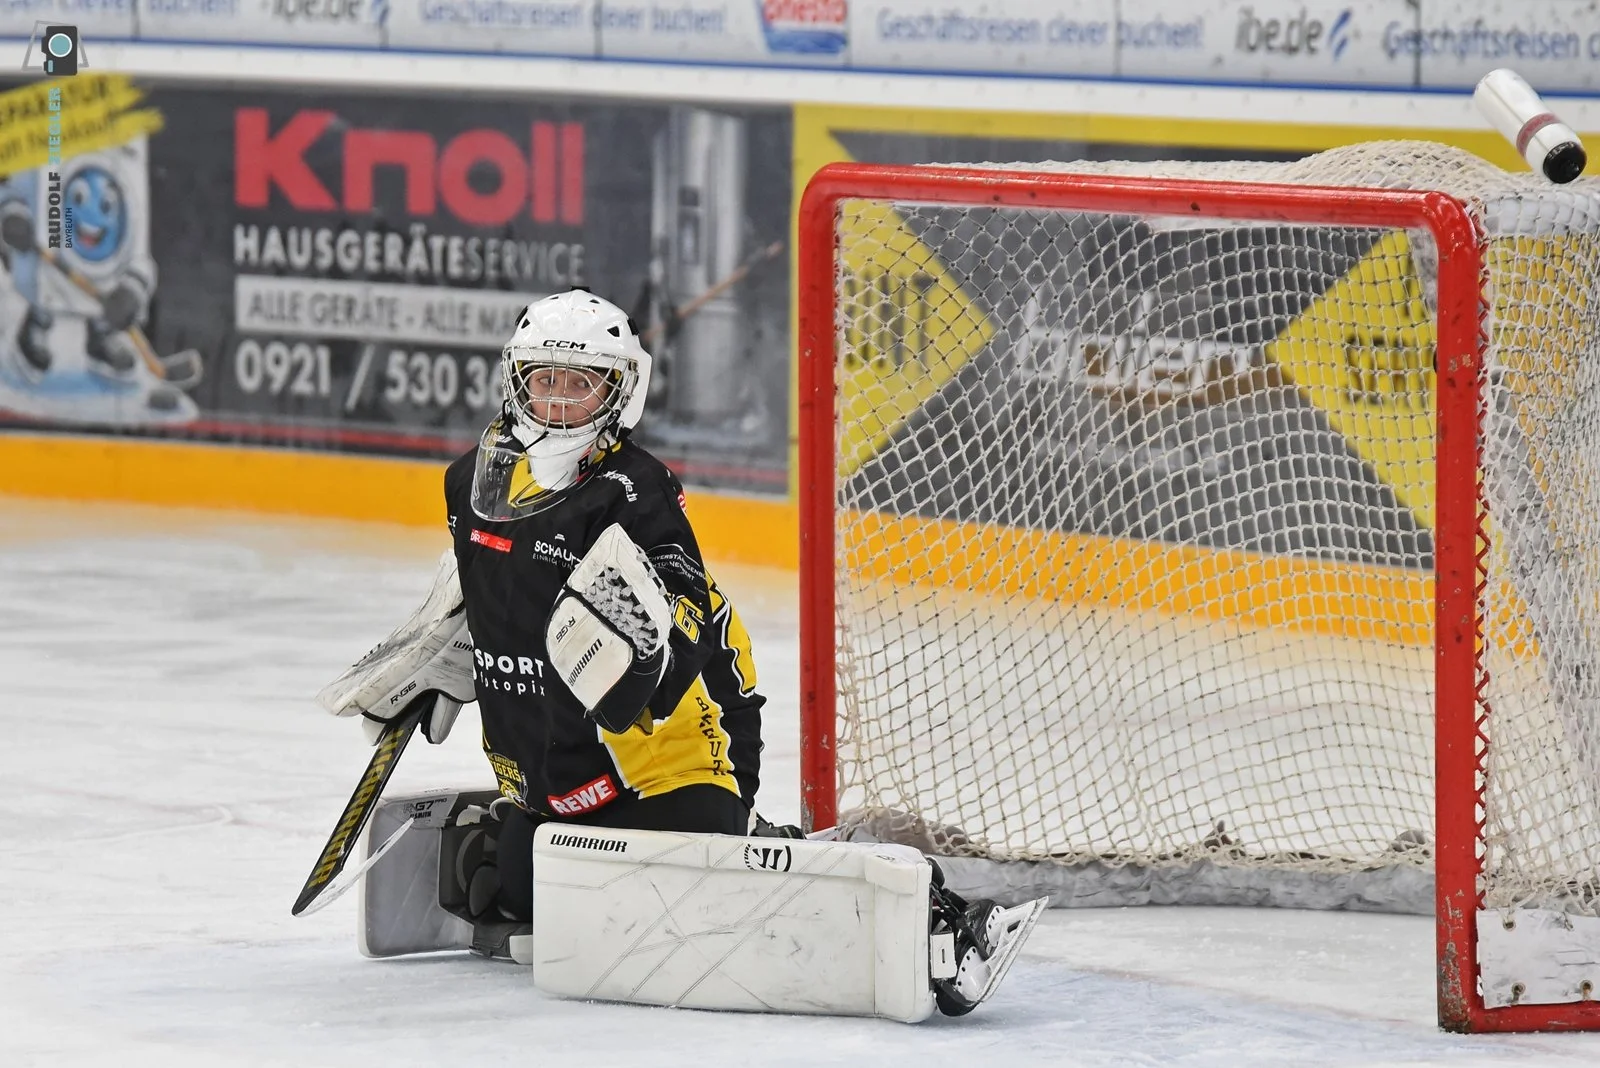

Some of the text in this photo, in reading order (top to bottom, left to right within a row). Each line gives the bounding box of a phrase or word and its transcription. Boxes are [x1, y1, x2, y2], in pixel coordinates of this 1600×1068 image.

[1234, 7, 1323, 54] ibe.de
[234, 107, 585, 228] Knoll
[233, 222, 586, 285] HAUSGERÄTESERVICE
[249, 287, 302, 323] ALLE
[307, 285, 400, 332] GERÄTE
[421, 301, 472, 335] ALLE
[542, 339, 587, 350] CCM
[234, 339, 333, 397] 0921
[384, 352, 460, 406] 530
[474, 648, 544, 678] SPORT
[567, 638, 603, 687] WARRIOR
[550, 779, 614, 815] REWE
[550, 834, 628, 854] WARRIOR
